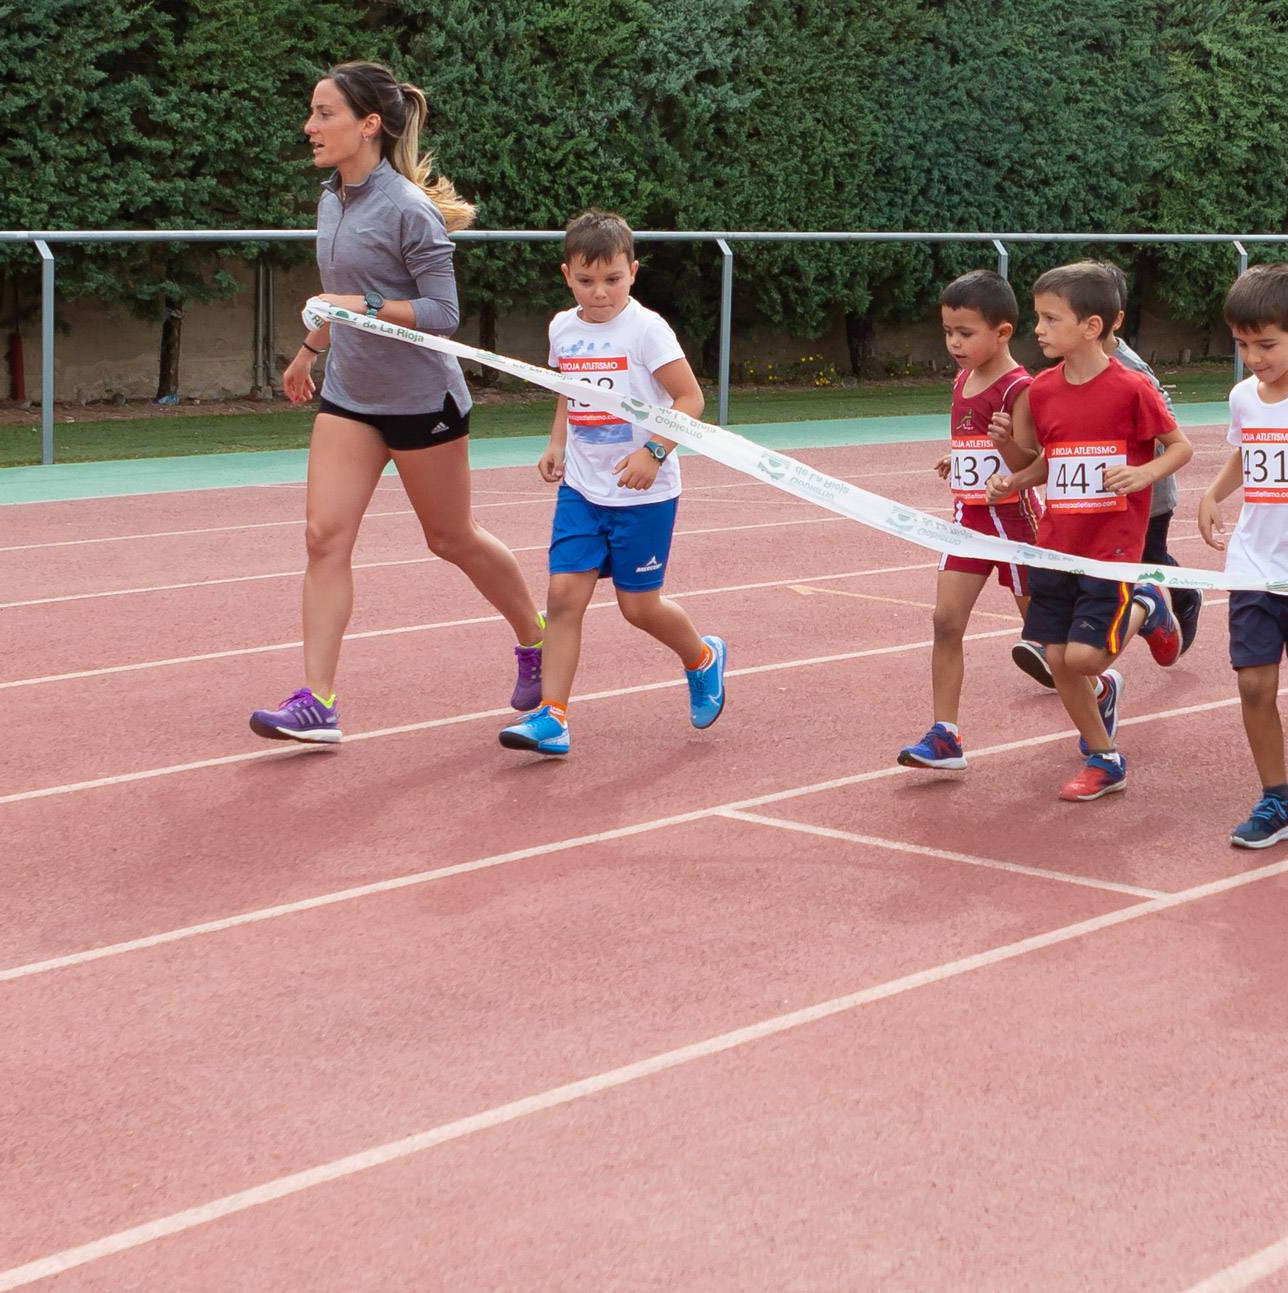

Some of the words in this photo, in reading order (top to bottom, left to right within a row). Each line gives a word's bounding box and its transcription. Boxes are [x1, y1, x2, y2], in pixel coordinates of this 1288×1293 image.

[380, 323, 393, 333] La
[396, 327, 425, 343] Rioja
[1074, 445, 1118, 455] ATLETISMO
[954, 455, 1001, 487] 432
[1055, 462, 1113, 494] 441
